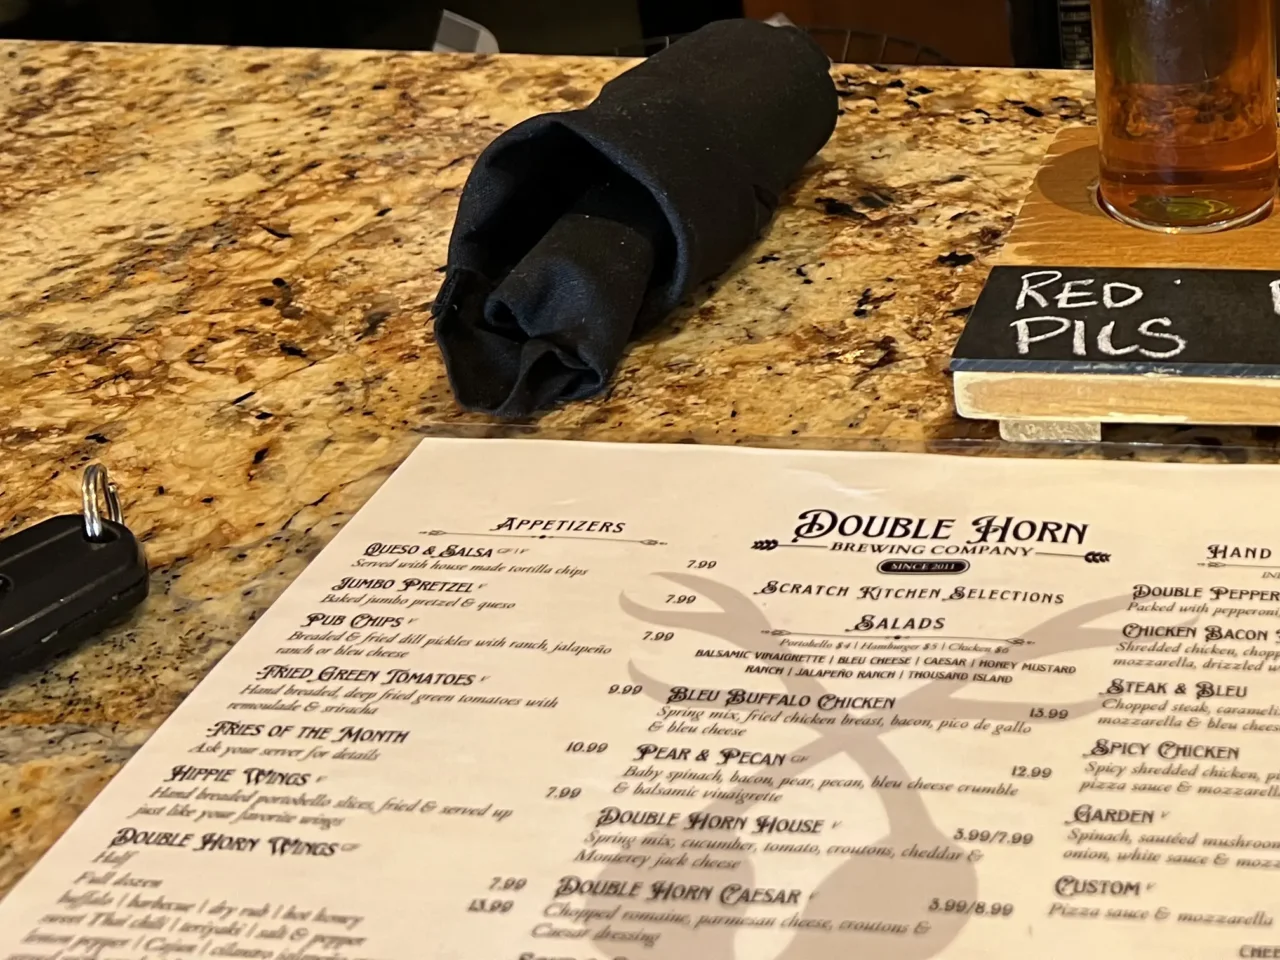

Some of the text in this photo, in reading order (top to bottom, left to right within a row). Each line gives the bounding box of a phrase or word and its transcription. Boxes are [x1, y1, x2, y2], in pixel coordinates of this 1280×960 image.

[1015, 271, 1144, 310] RED
[1009, 315, 1188, 358] PILS
[489, 516, 626, 533] APPETIZERS
[792, 509, 1089, 545] DOUBLE HORN
[362, 541, 493, 558] QUESO & SALSA
[828, 541, 1035, 558] BREWING COMPANY
[1206, 544, 1273, 560] HAND
[350, 557, 588, 578] Served with house made tortilla chips
[686, 559, 717, 569] 7.99
[891, 562, 956, 573] SINCE 2011
[330, 576, 473, 593] JUMBO PRETZEL
[752, 580, 1064, 604] SCRATCH KITCHEN SELECTIONS
[1131, 583, 1203, 600] DOUBLE
[320, 593, 367, 605] Baked
[362, 594, 409, 607] jumbo
[410, 596, 462, 609] pretzel
[476, 601, 516, 611] queso
[664, 593, 697, 604] 7.99
[1126, 601, 1177, 613] Packed
[1178, 602, 1209, 614] with
[299, 611, 404, 628] PUB CHIPS
[844, 614, 945, 632] SALADS
[288, 630, 345, 641] Breaded
[363, 632, 399, 646] fried
[398, 634, 425, 645] dill
[423, 636, 472, 649] pickles
[473, 638, 506, 648] with
[641, 630, 675, 642] 7.99
[1121, 622, 1197, 639] CHICKEN
[1203, 624, 1268, 641] BACON
[693, 648, 1077, 675] BALSAMIC VINAIGRETTE BLEU CHEESE CAESAR HONEY MUSTARD
[254, 664, 477, 686] FRIED GREEN TOMATOES
[743, 664, 785, 675] RANCH
[855, 669, 896, 679] RANCH
[907, 669, 969, 682] THOUSAND
[971, 672, 1013, 684] ISLAND
[607, 684, 643, 695] 9.99
[664, 686, 896, 710] BLEU BUFFALO CHICKEN
[1098, 678, 1248, 699] STEAK & BLEU
[646, 720, 747, 737] & bleu cheese
[655, 705, 1032, 736] Spring mix, fried chicken breast, bacon, pico de gallo
[205, 720, 410, 743] FRIES OF THE MONTH
[564, 740, 609, 753] 10.99
[631, 743, 787, 766] PEAR & PECAN
[1081, 738, 1240, 760] SPICY CHICKEN
[162, 765, 311, 786] HIPPIE WINGS
[1010, 764, 1053, 779] 12.99
[544, 785, 582, 799] 7.99
[594, 806, 824, 834] DOUBLE HORN HOUSE
[1063, 804, 1155, 826] GARDEN
[110, 828, 341, 857] DOUBLE HORN WINGS
[487, 876, 528, 892] 7.99
[552, 875, 802, 906] DOUBLE HORN CAESAR
[1053, 875, 1142, 898] CUSTOM
